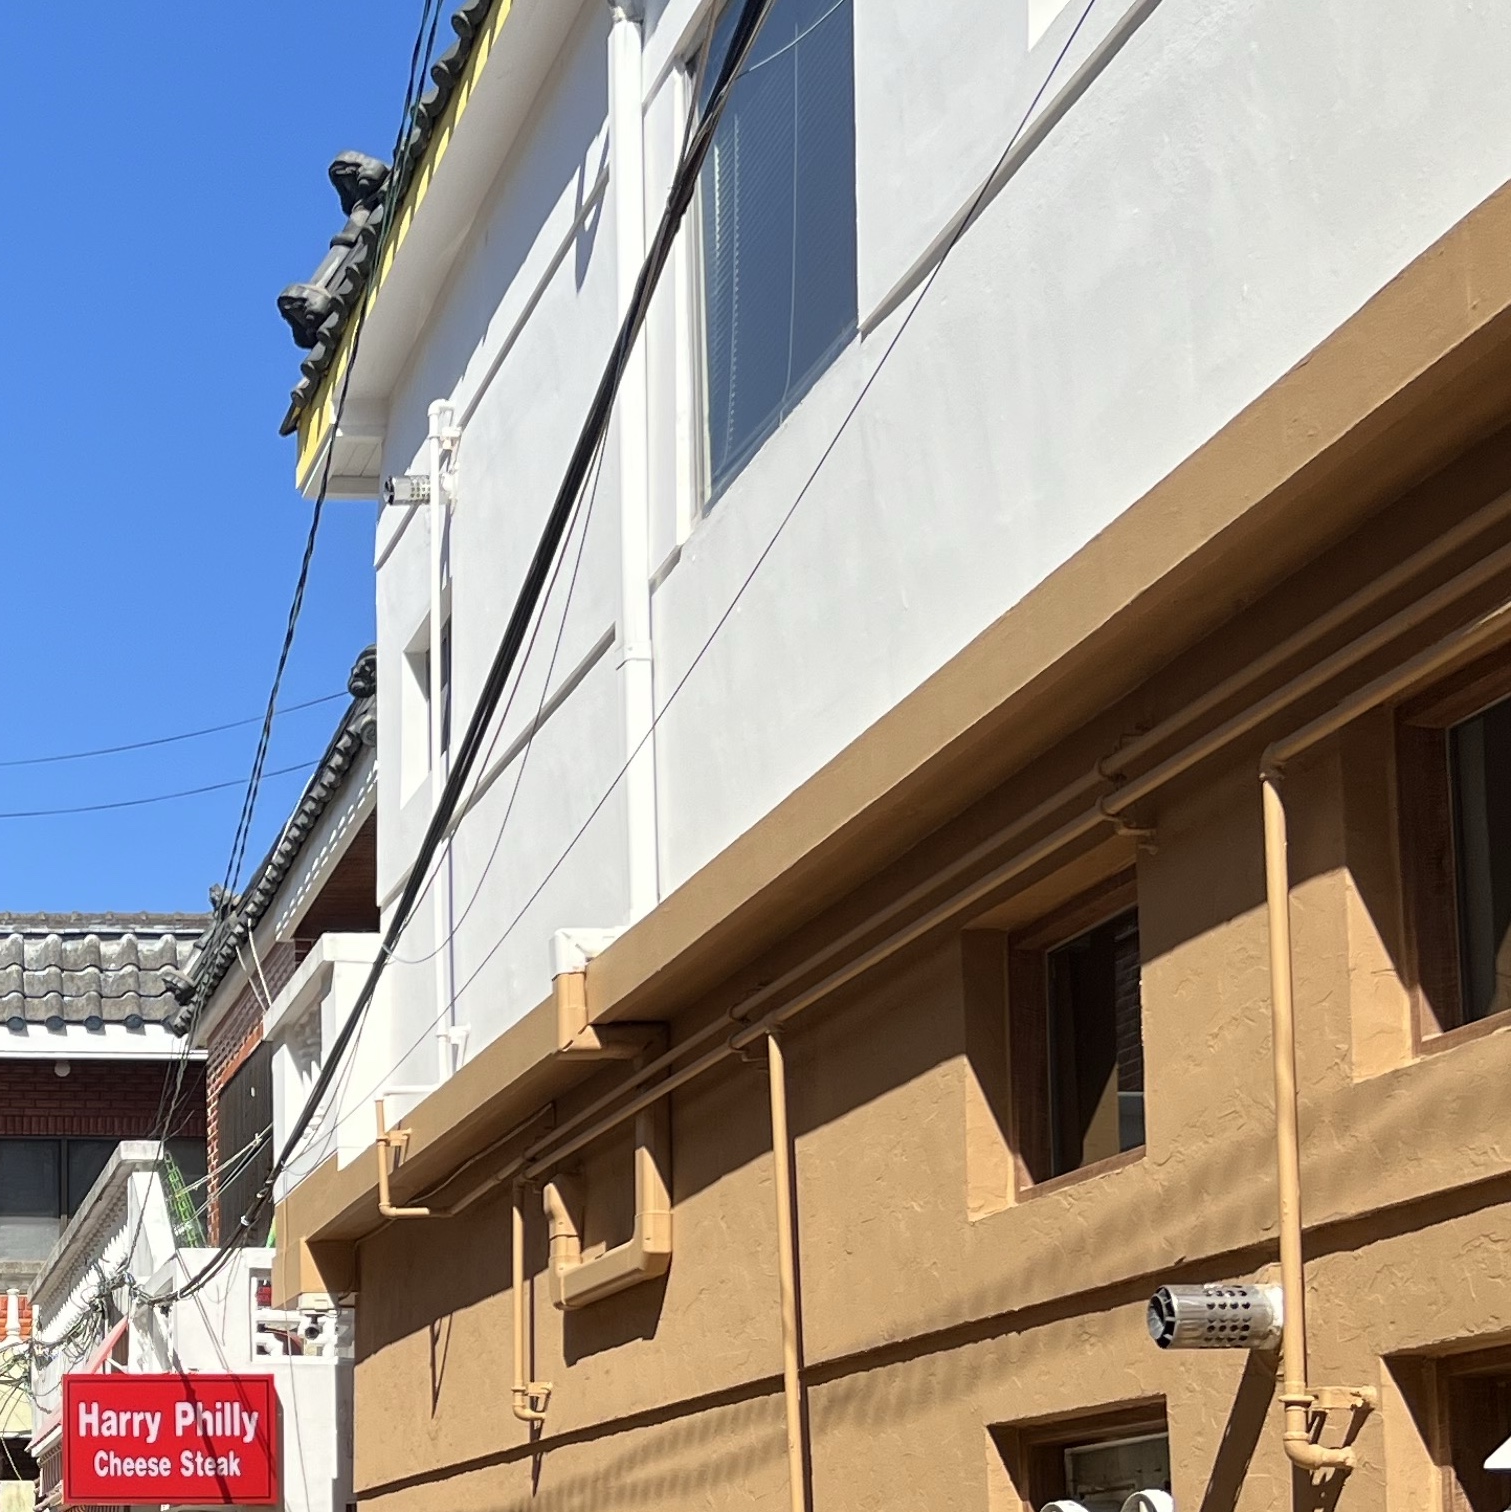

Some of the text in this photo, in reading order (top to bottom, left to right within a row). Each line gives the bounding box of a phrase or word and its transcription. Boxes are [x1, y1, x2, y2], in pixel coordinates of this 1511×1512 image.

[78, 1401, 259, 1443] Harry Philly
[93, 1449, 241, 1477] Cheese Steak
